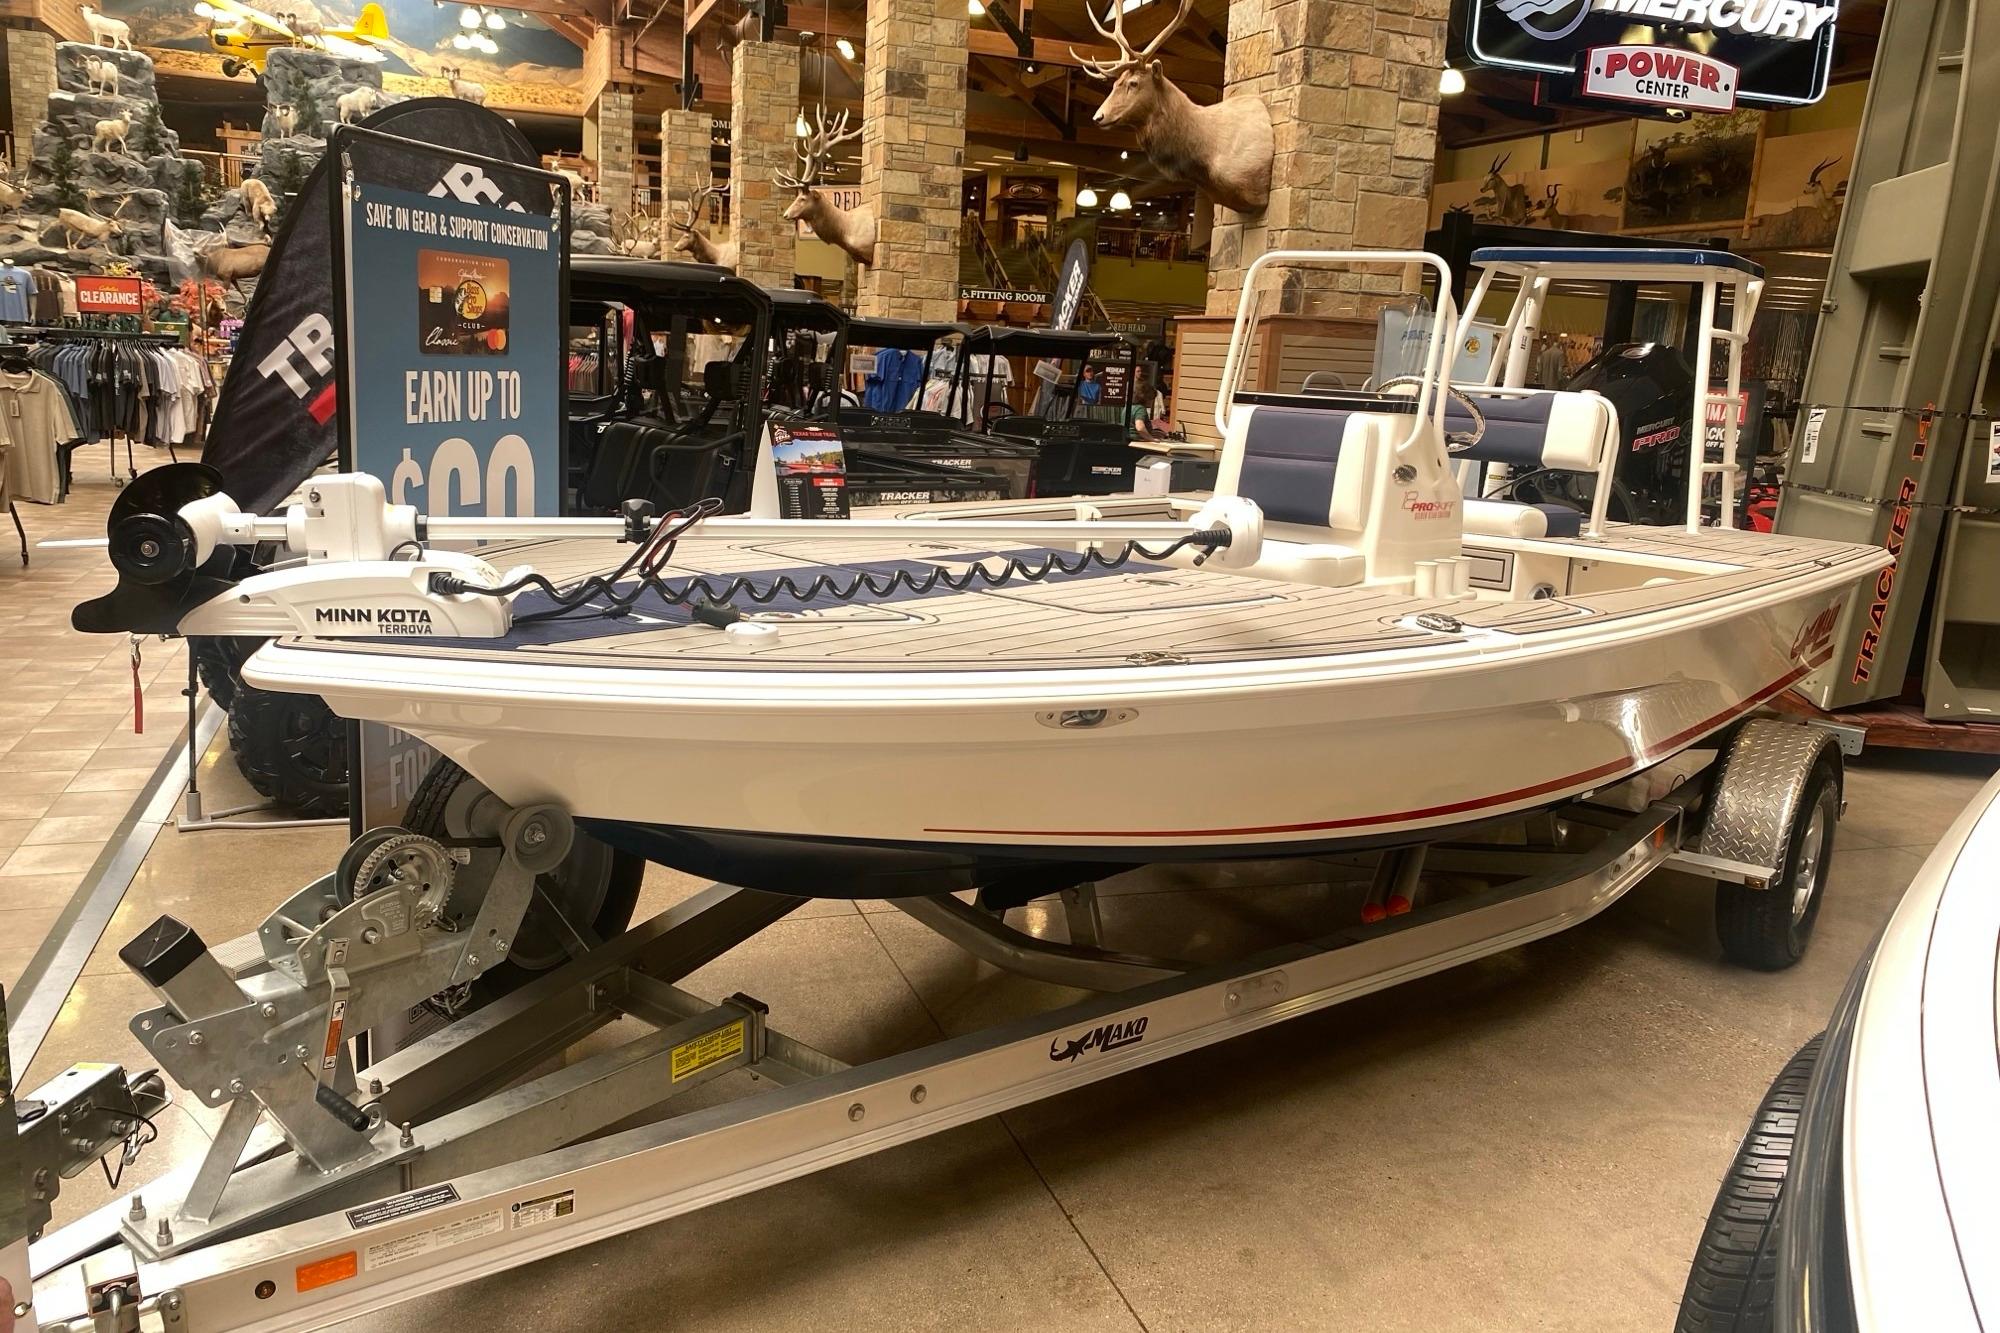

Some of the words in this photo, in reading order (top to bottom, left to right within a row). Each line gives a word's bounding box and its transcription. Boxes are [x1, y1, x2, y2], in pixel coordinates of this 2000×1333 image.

[1604, 51, 1720, 93] POWER
[1635, 78, 1690, 99] CENTER
[366, 201, 393, 229] SAVE
[395, 208, 410, 231] ON
[412, 213, 438, 236] GEAR
[439, 216, 448, 237] &
[449, 218, 489, 243] SUPPORT
[491, 222, 549, 251] CONSERVATION
[80, 290, 139, 305] CLEARANCE
[970, 289, 1013, 301] FITTING
[1015, 292, 1046, 303] ROOM
[425, 326, 459, 346] Classic
[462, 322, 481, 330] CLUB
[405, 370, 462, 424] EARN
[467, 370, 494, 422] UP
[497, 370, 521, 420] TO
[1636, 416, 1676, 435] MERCURY
[1631, 426, 1681, 452] PRO
[880, 491, 930, 501] TRACKER
[1852, 476, 1918, 685] TRACKER
[315, 608, 372, 622] MINN
[377, 608, 432, 623] KOTA
[377, 624, 433, 635] TERROVA
[1084, 1016, 1149, 1053] MAKO
